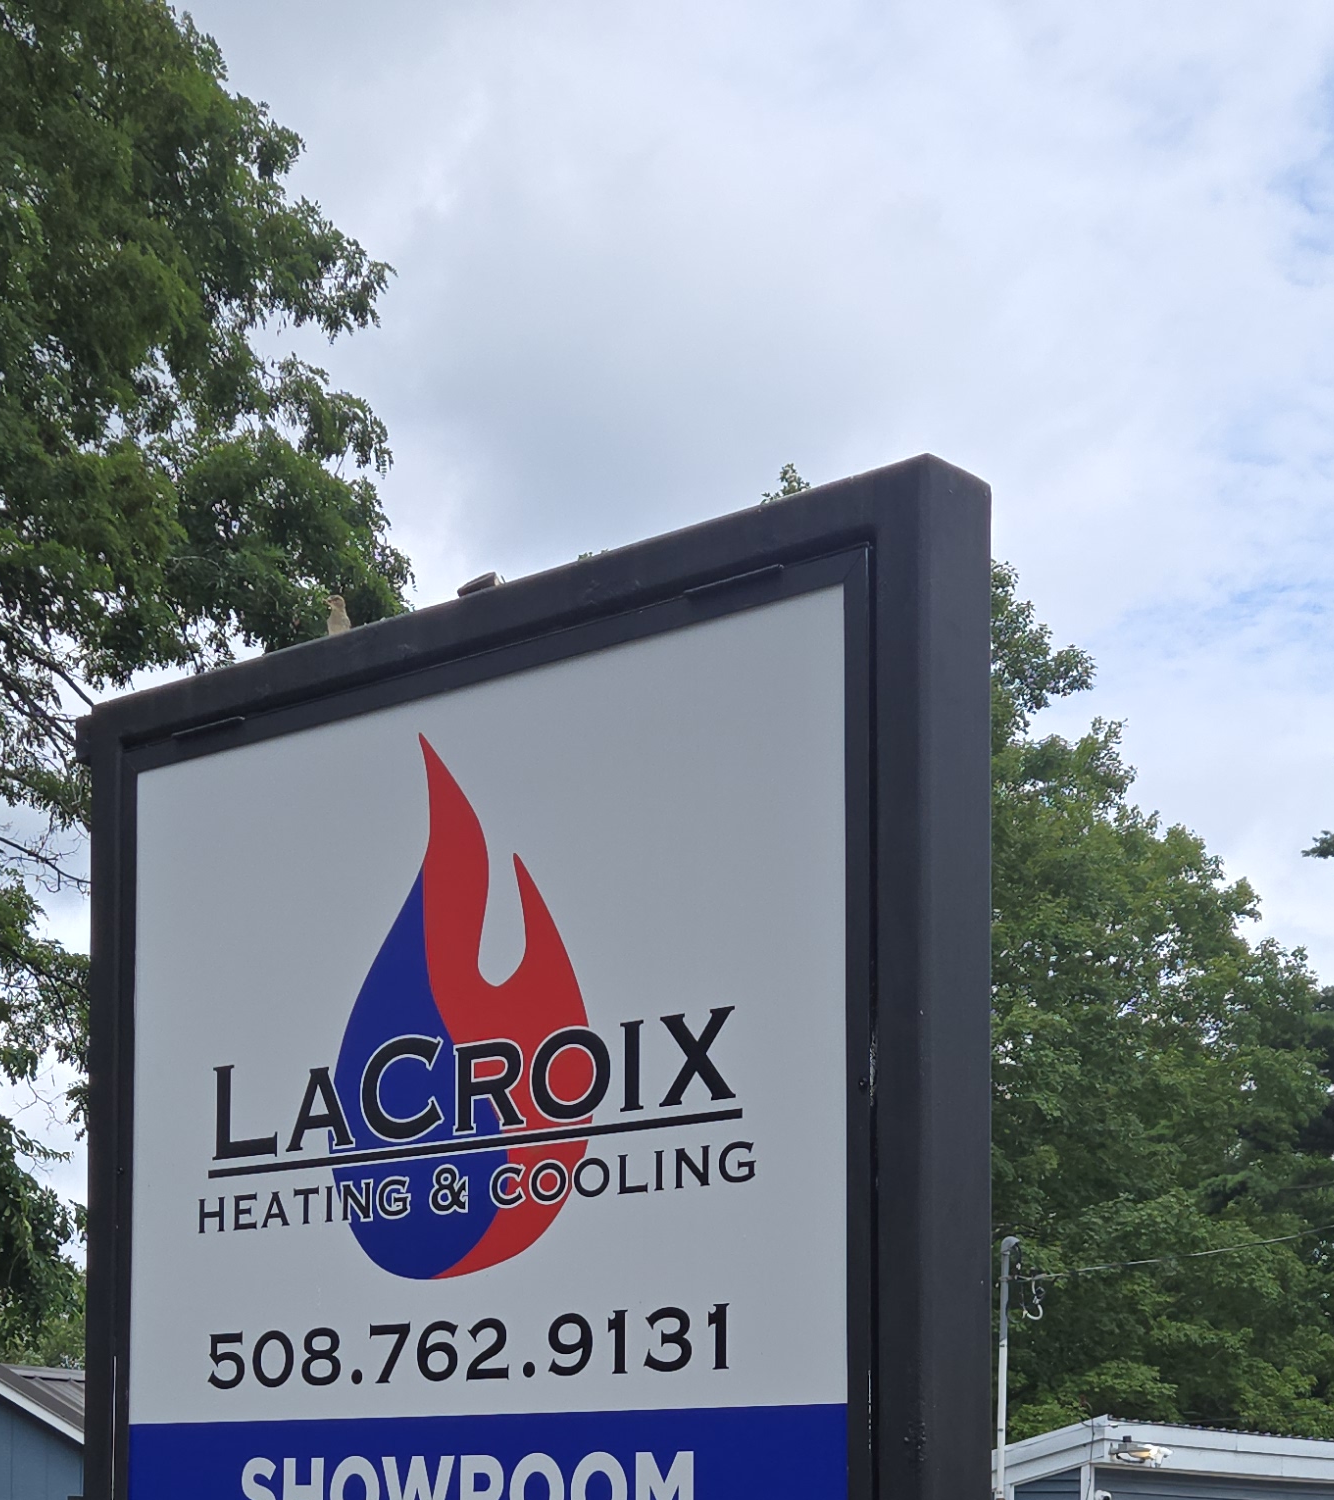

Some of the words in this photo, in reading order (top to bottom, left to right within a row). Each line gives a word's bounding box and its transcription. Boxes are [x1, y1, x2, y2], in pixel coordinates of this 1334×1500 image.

[212, 1006, 736, 1161] LACROIX
[198, 1175, 411, 1234] HEATING
[430, 1165, 469, 1215] &
[491, 1141, 757, 1210] COOLING
[207, 1303, 731, 1391] 508.762.9131
